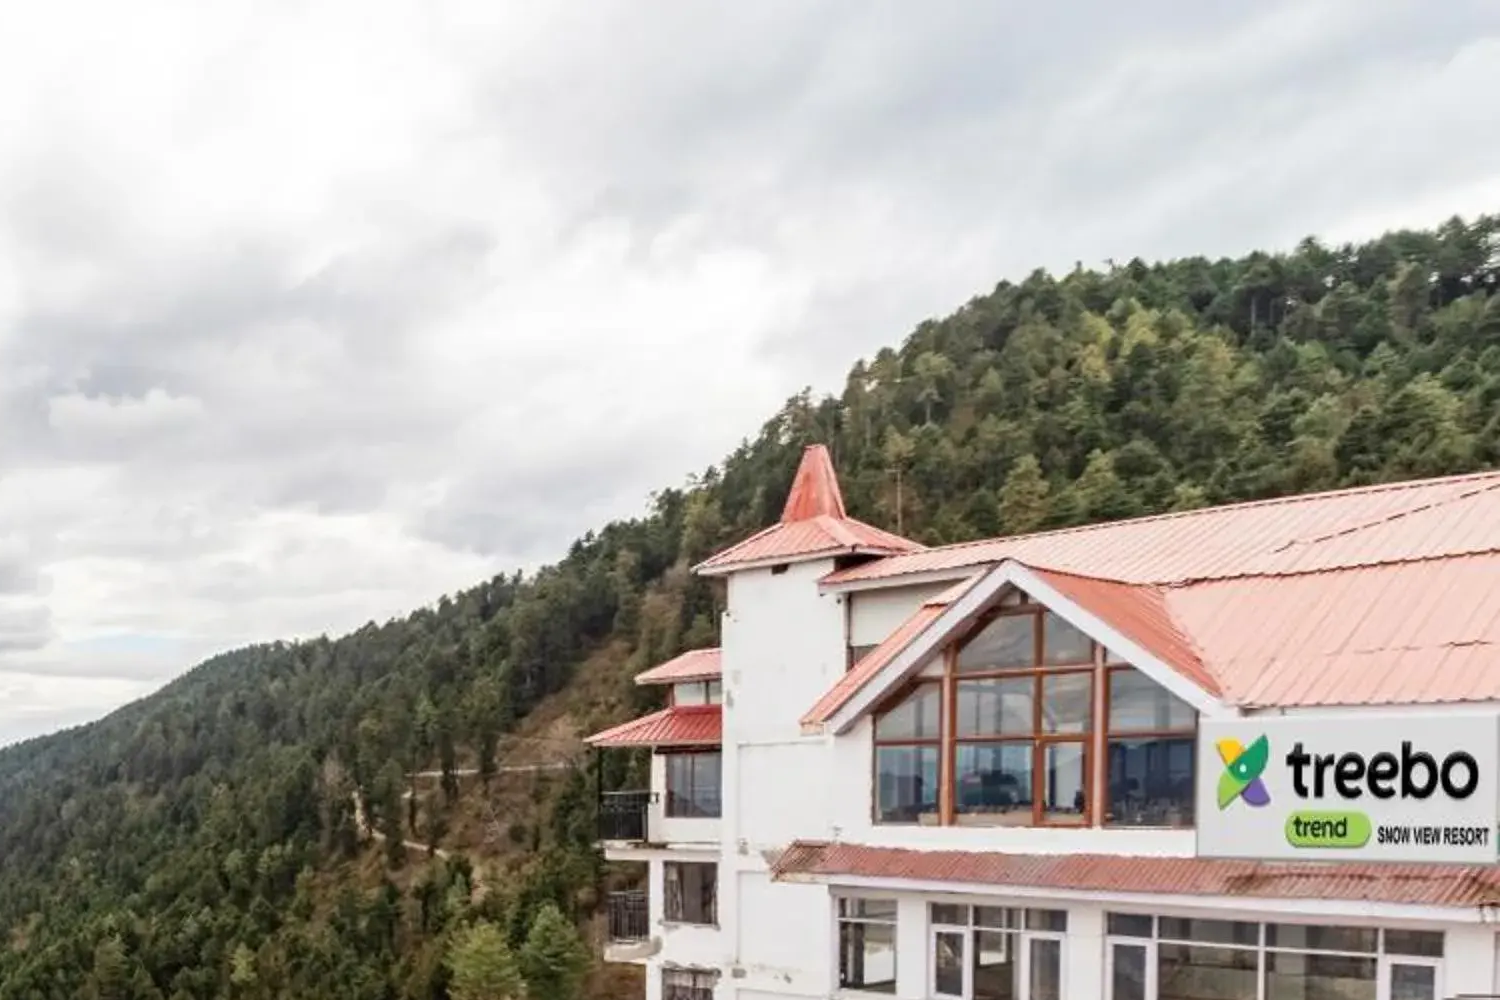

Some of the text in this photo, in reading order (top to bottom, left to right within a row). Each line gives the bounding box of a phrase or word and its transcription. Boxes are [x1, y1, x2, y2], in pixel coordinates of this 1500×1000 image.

[1286, 741, 1479, 800] treebo
[1294, 817, 1347, 838] trend
[1377, 827, 1490, 846] SNOW VIEW RESORT
